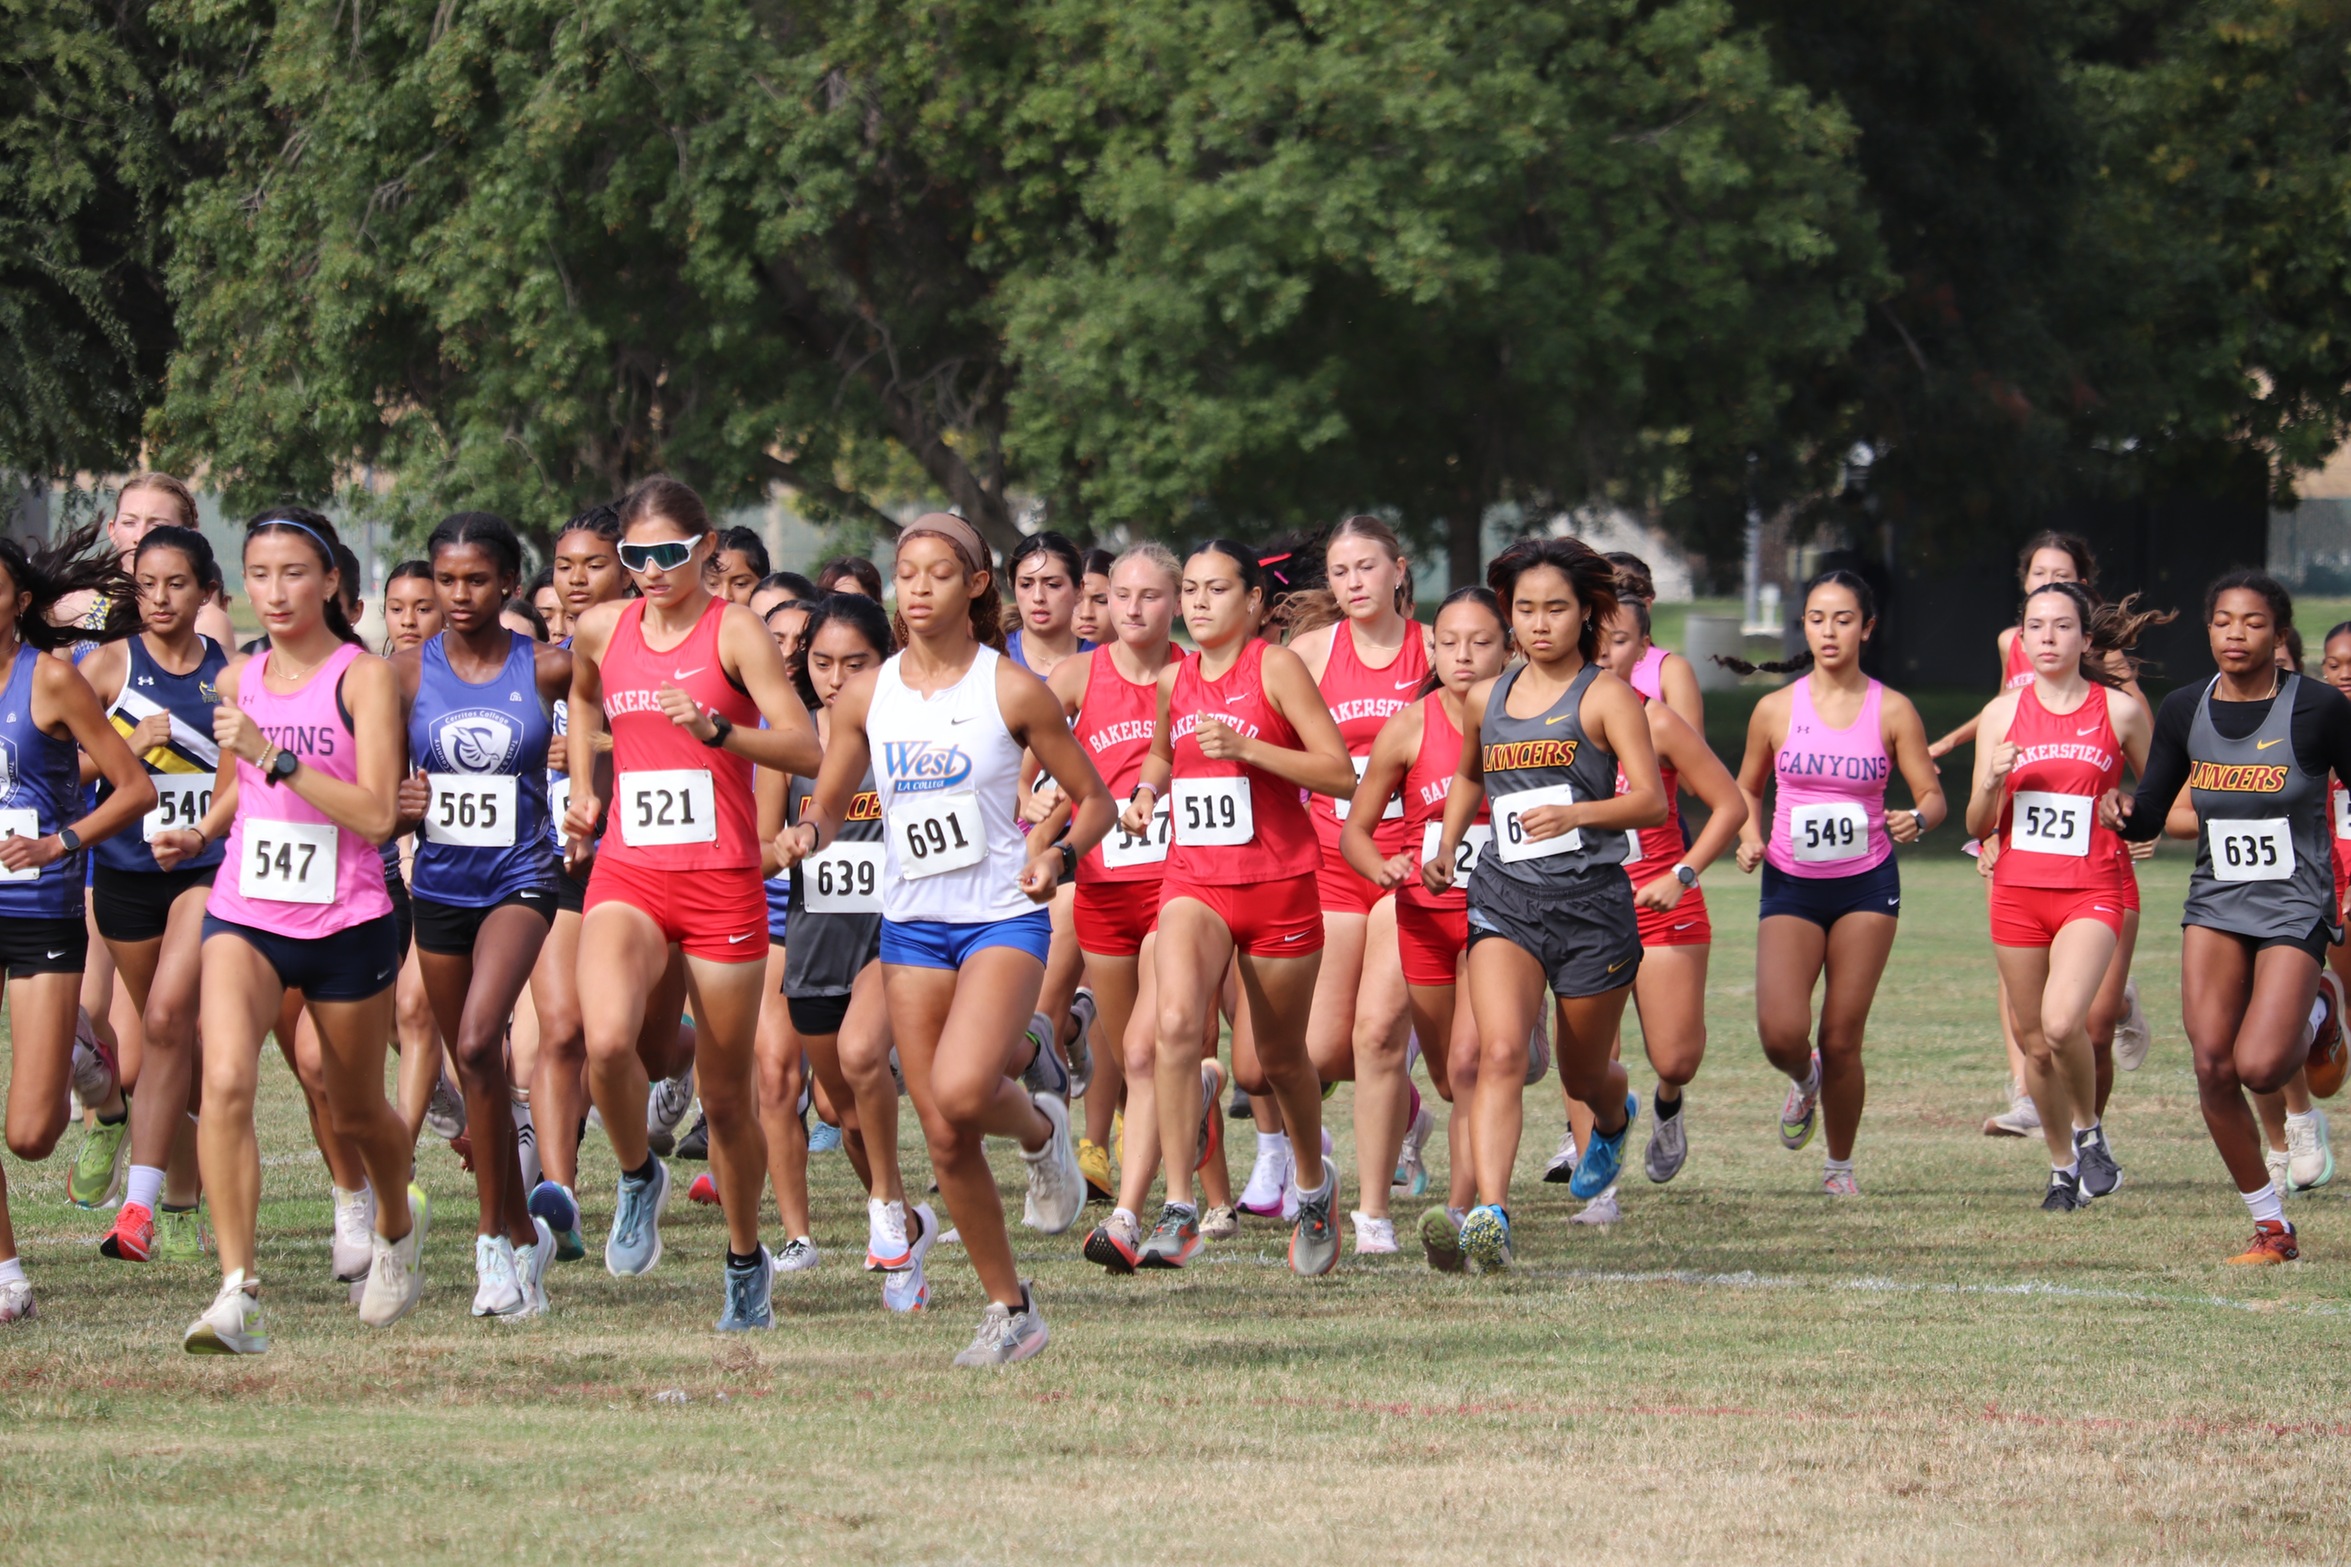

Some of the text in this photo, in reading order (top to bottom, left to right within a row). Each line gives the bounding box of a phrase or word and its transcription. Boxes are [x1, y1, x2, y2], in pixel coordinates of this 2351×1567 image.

[445, 710, 509, 725] Cerritos College
[506, 740, 518, 759] Track
[1089, 720, 1157, 753] BAKERS
[434, 739, 450, 769] Country
[882, 740, 959, 778] West
[1483, 740, 1577, 772] LANCERS
[1779, 751, 1887, 780] CANYONS
[897, 780, 945, 791] LA COLLEGE
[2191, 761, 2288, 792] LANCERS
[440, 792, 497, 828] 565
[636, 789, 695, 827] 521
[1185, 795, 1235, 829] 519
[2026, 806, 2075, 839] 525
[906, 812, 969, 859] 691
[1805, 817, 1854, 848] 549
[256, 840, 316, 882] 547
[2225, 835, 2277, 866] 635
[818, 860, 875, 896] 639
